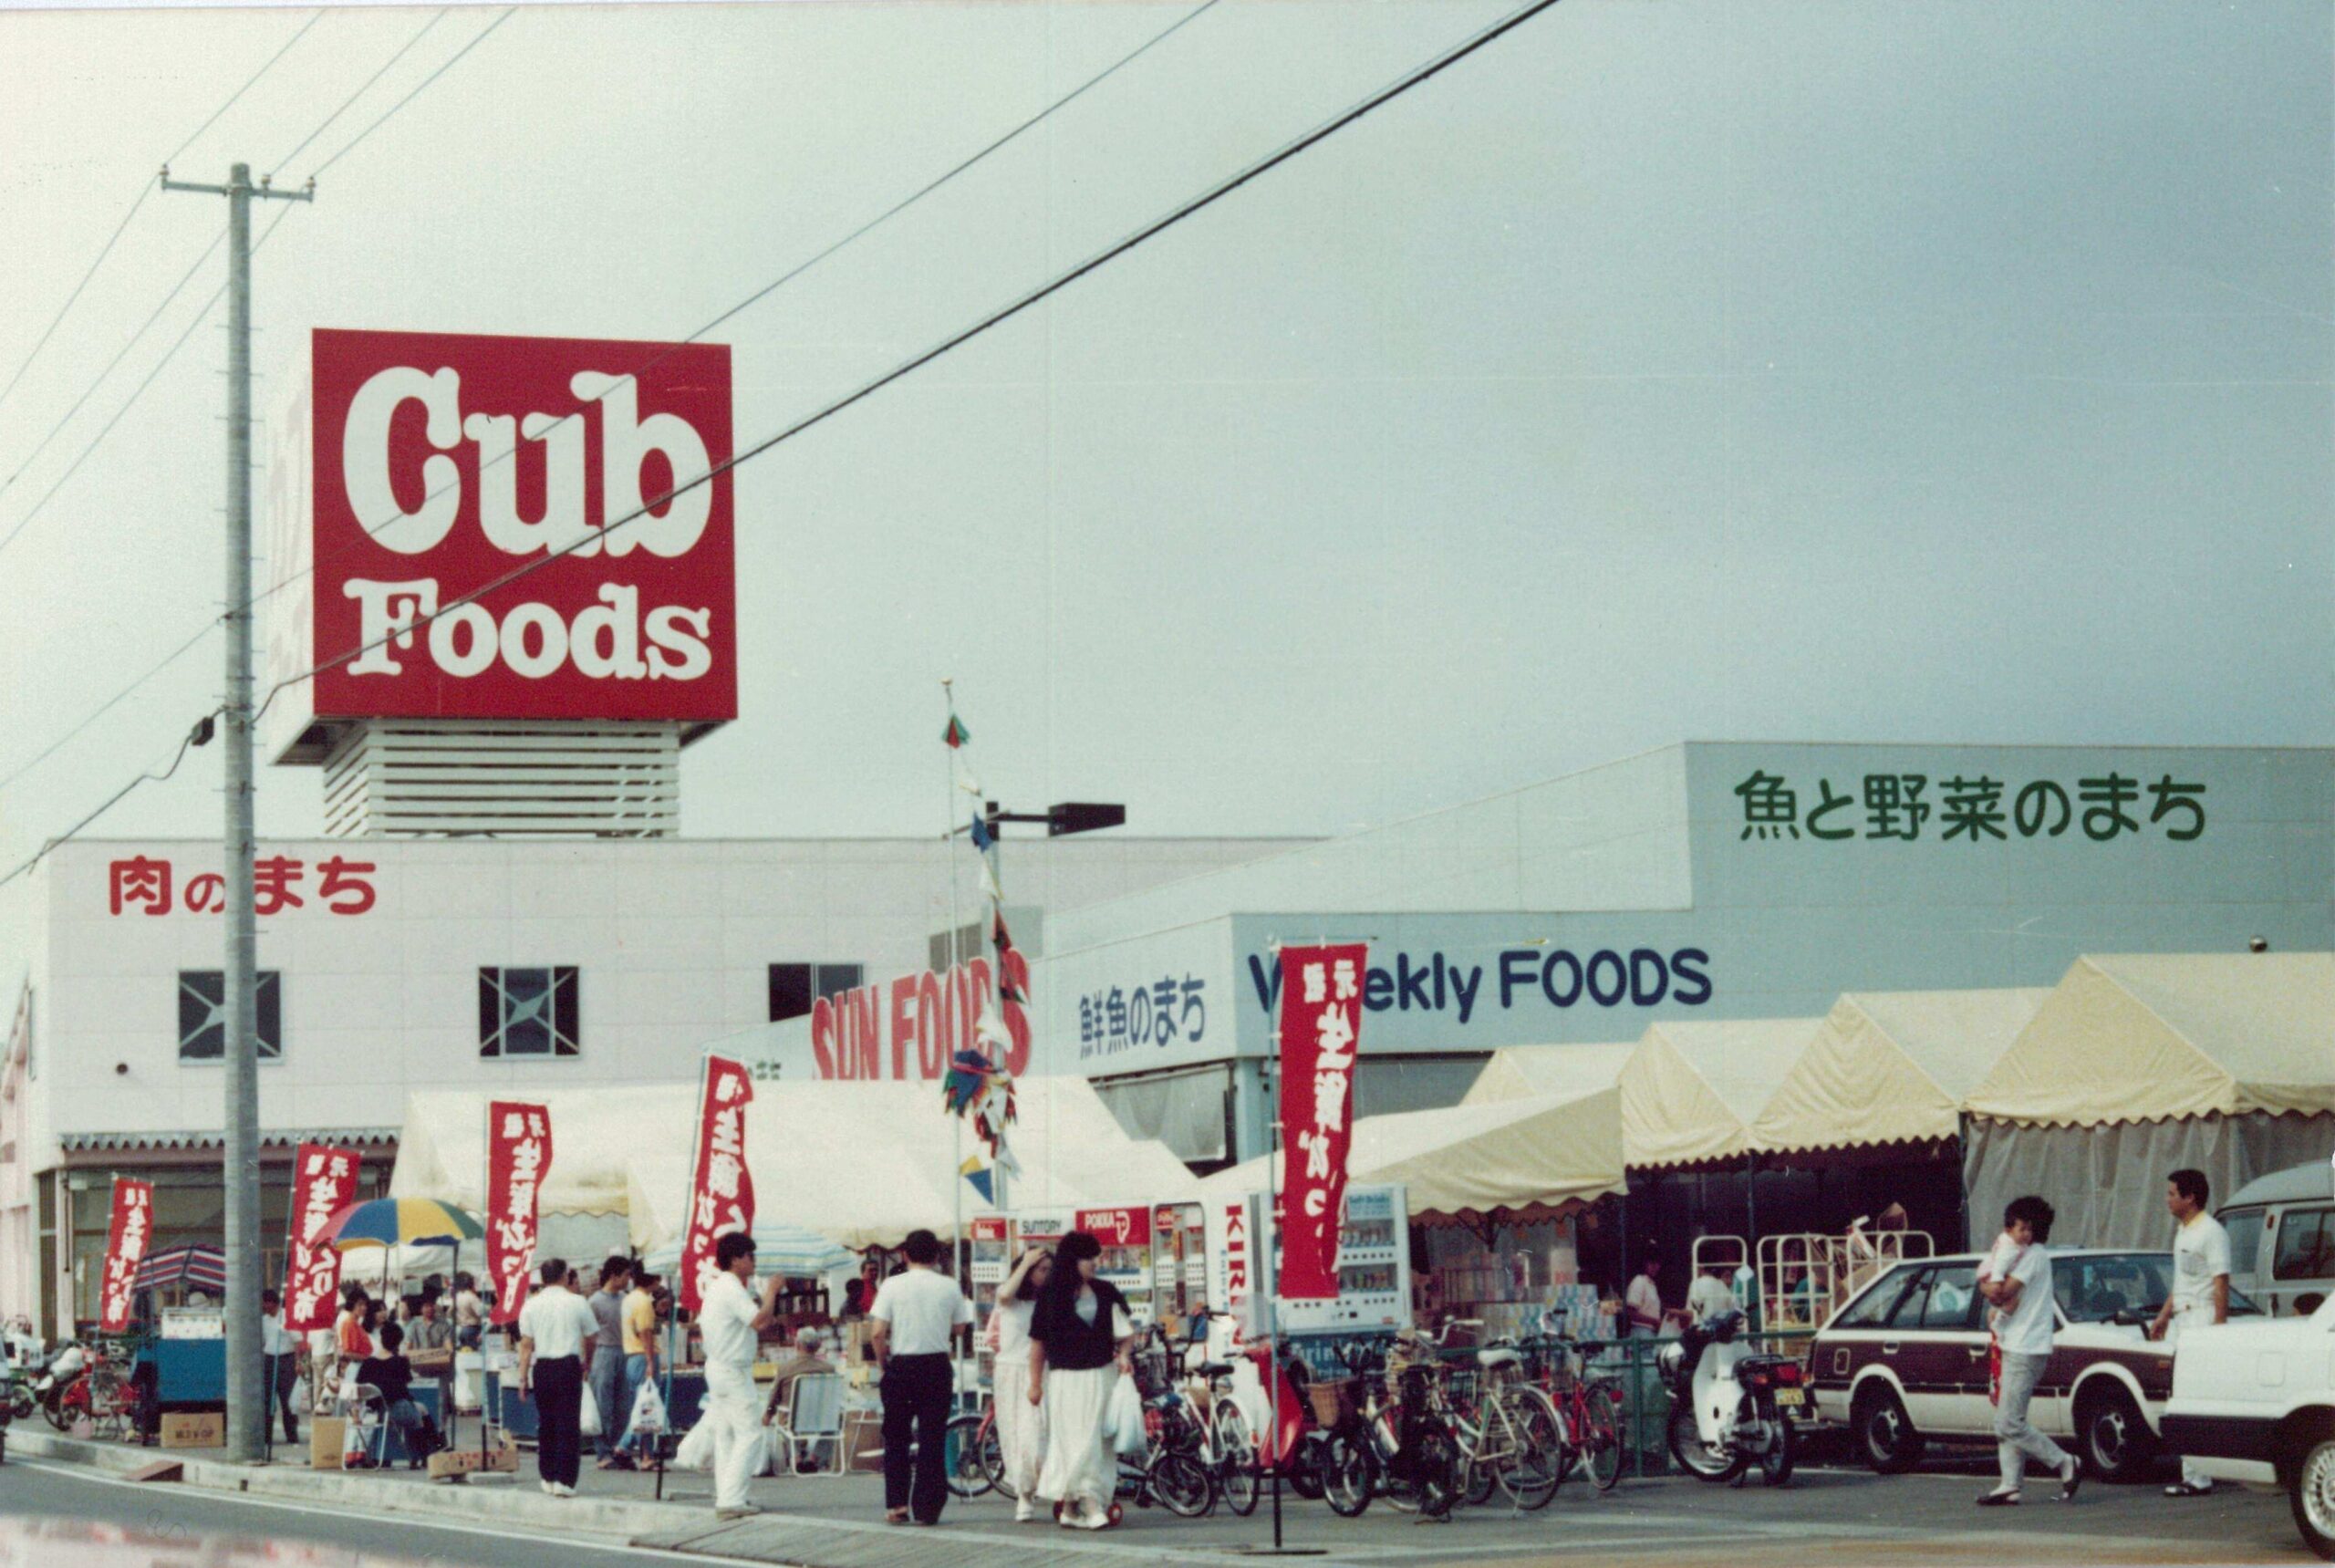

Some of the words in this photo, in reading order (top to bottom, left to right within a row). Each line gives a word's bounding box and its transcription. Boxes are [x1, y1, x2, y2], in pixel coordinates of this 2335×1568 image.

[343, 366, 712, 557] Cub
[343, 577, 712, 680] Foods
[1734, 770, 2206, 841] 魚と野菜のまち
[1079, 972, 1205, 1060] 鮮魚のまち
[1500, 948, 1712, 1008] FOODS
[812, 984, 880, 1080] SUN
[1084, 1212, 1116, 1229] POKKA
